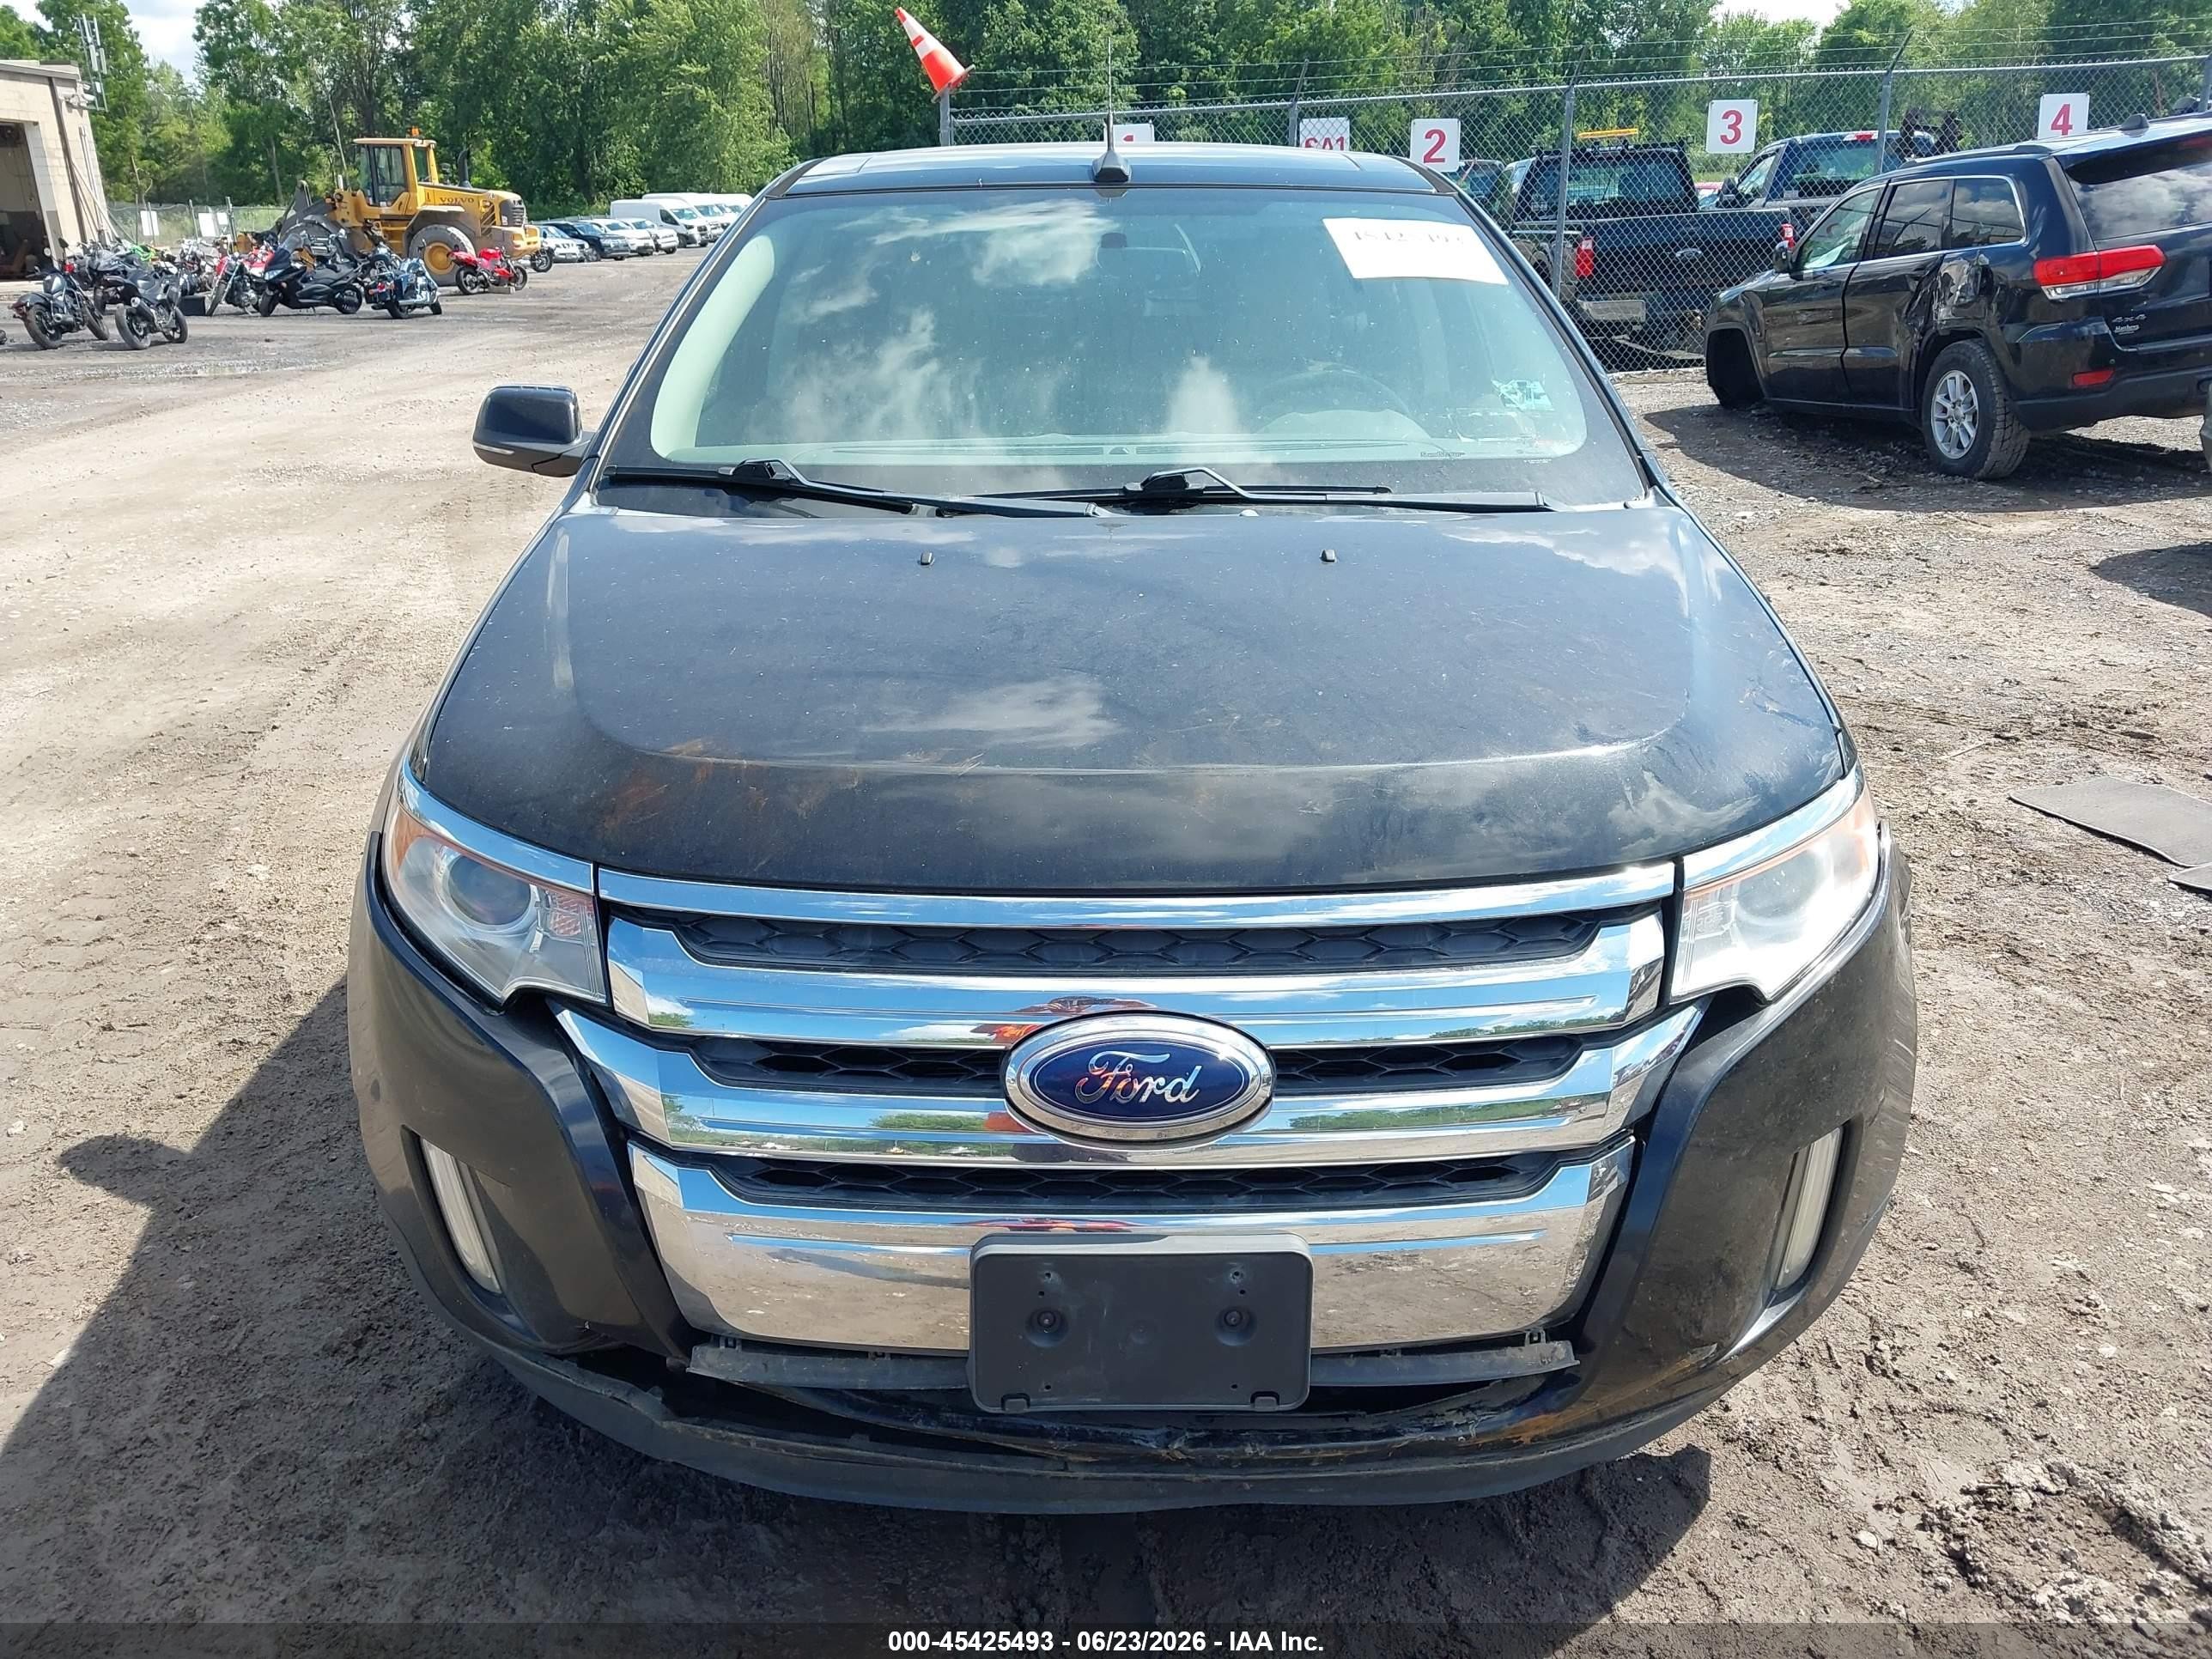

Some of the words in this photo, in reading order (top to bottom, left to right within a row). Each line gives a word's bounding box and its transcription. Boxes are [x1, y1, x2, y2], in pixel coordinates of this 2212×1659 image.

[1720, 110, 1742, 144] 3
[2051, 103, 2073, 136] 4
[1423, 129, 1446, 163] 2
[1075, 1050, 1202, 1104] Ford
